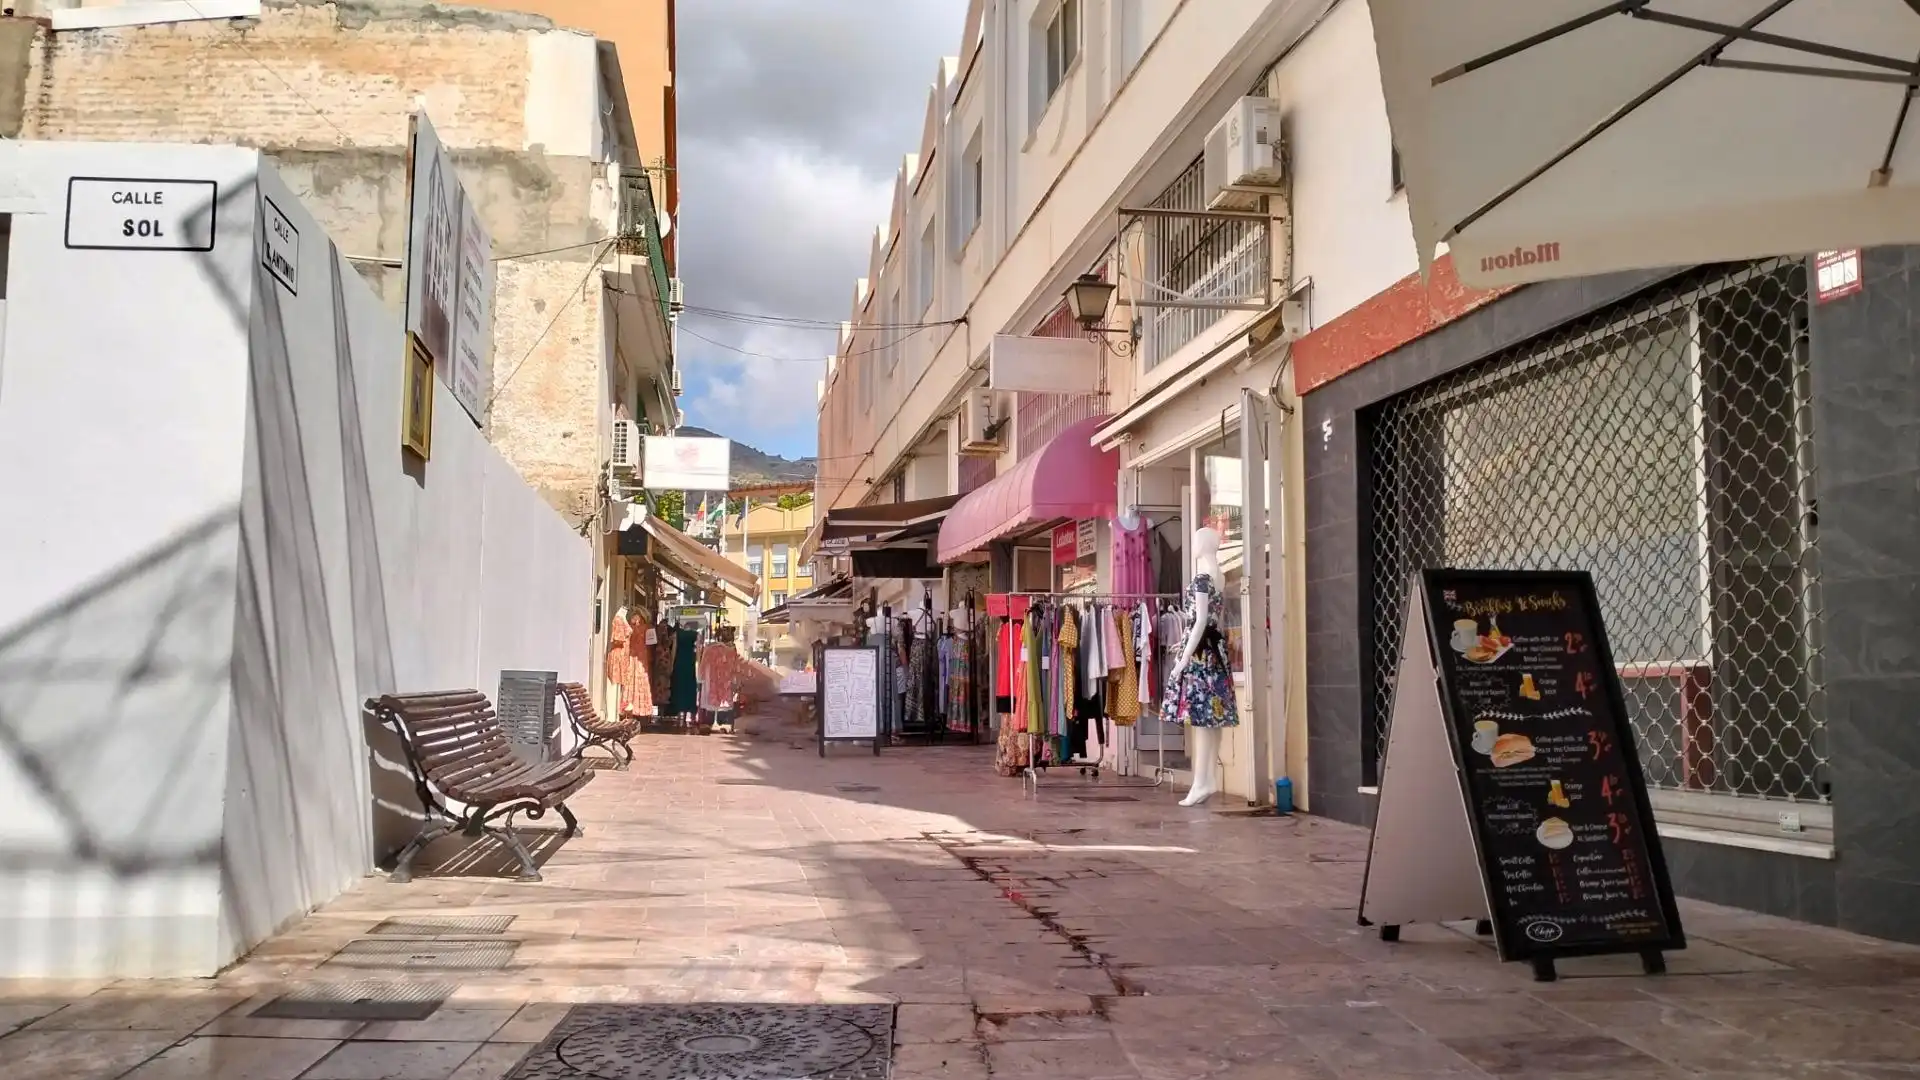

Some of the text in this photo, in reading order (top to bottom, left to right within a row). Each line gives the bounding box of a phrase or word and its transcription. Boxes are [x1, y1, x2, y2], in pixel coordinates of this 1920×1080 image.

[111, 191, 163, 205] CALLE
[122, 218, 164, 237] SOL
[273, 217, 289, 244] CALLE
[271, 248, 295, 284] ANTONIO
